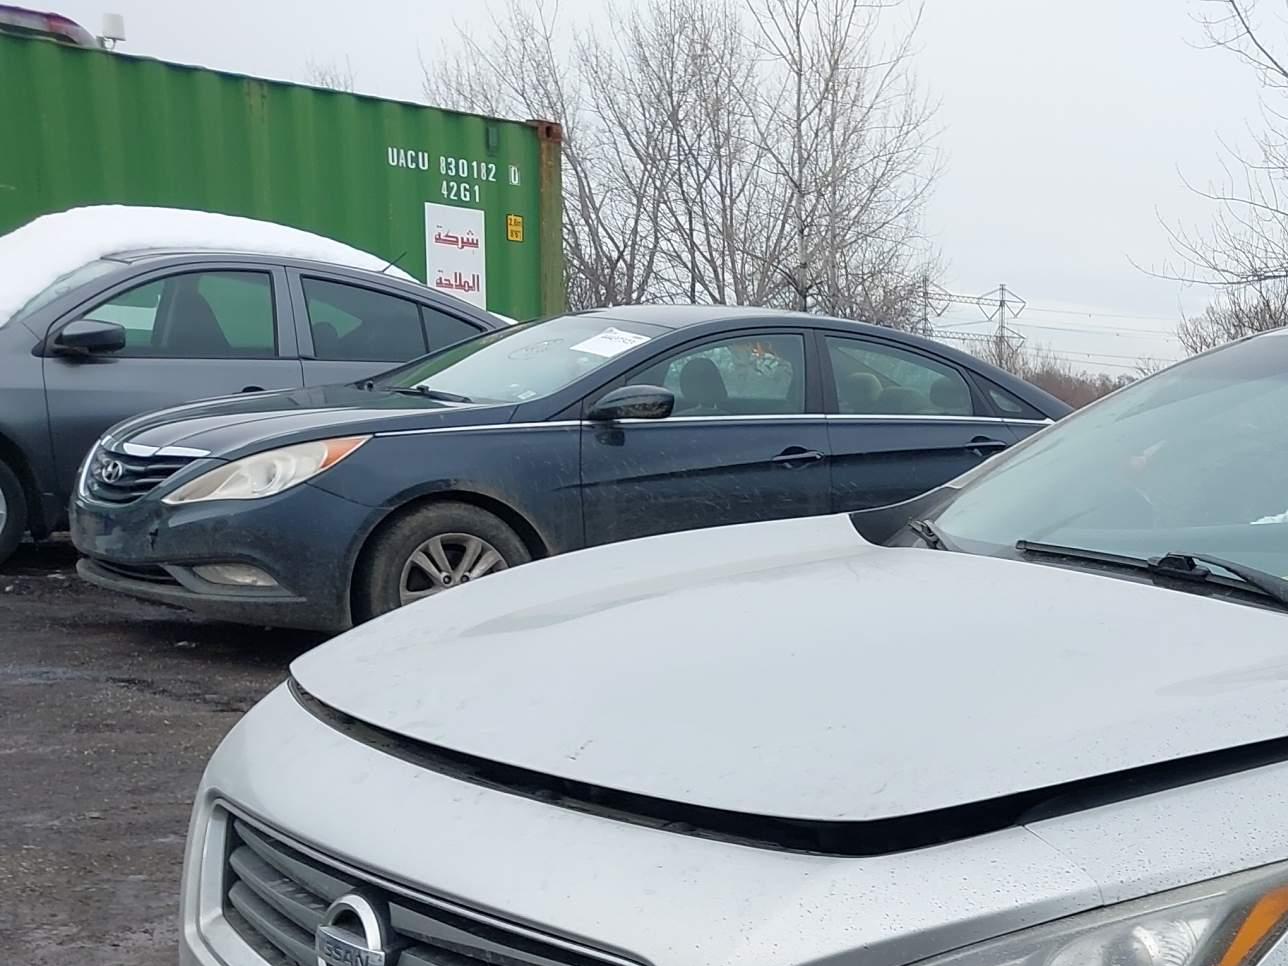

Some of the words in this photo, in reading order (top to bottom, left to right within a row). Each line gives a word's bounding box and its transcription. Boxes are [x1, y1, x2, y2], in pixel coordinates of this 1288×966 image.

[388, 147, 428, 170] UACU
[440, 156, 496, 181] 830182
[441, 180, 479, 202] 42G1
[434, 224, 480, 250] شركة
[435, 269, 480, 293] الملاحة
